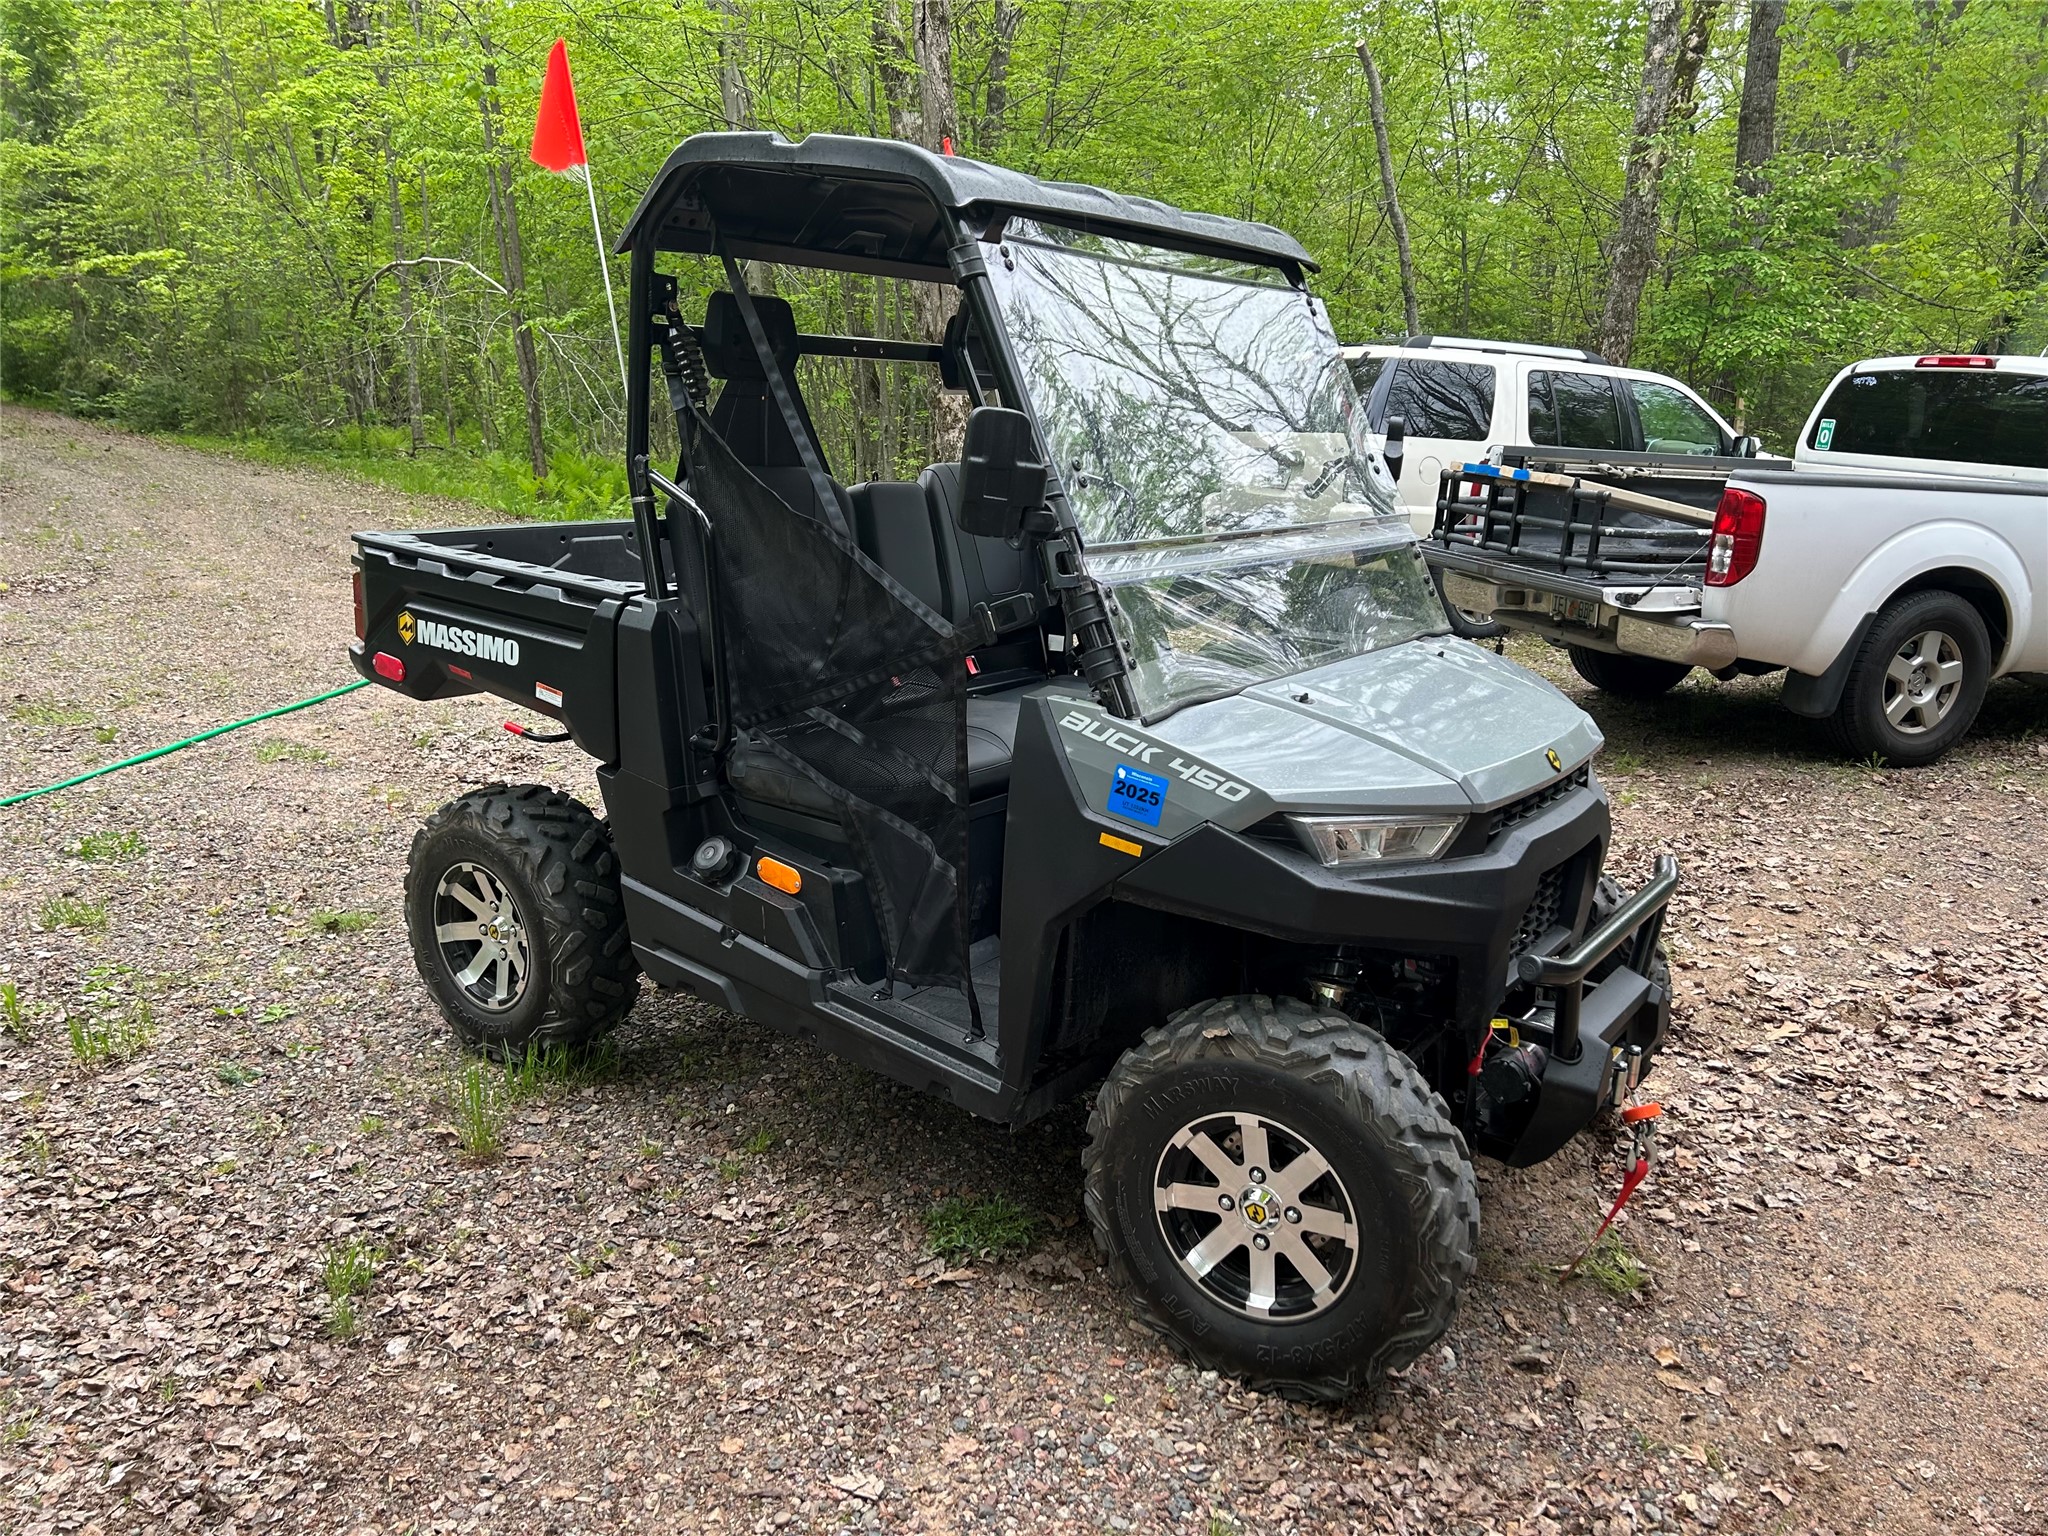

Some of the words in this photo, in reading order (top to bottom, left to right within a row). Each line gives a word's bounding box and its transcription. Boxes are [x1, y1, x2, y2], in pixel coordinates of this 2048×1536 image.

[1820, 429, 1830, 444] 0
[417, 618, 520, 667] MASSIMO
[1059, 710, 1164, 763] BUCK
[1168, 758, 1251, 802] 450
[1114, 780, 1161, 807] 2025
[1143, 1076, 1240, 1120] MARSWAY
